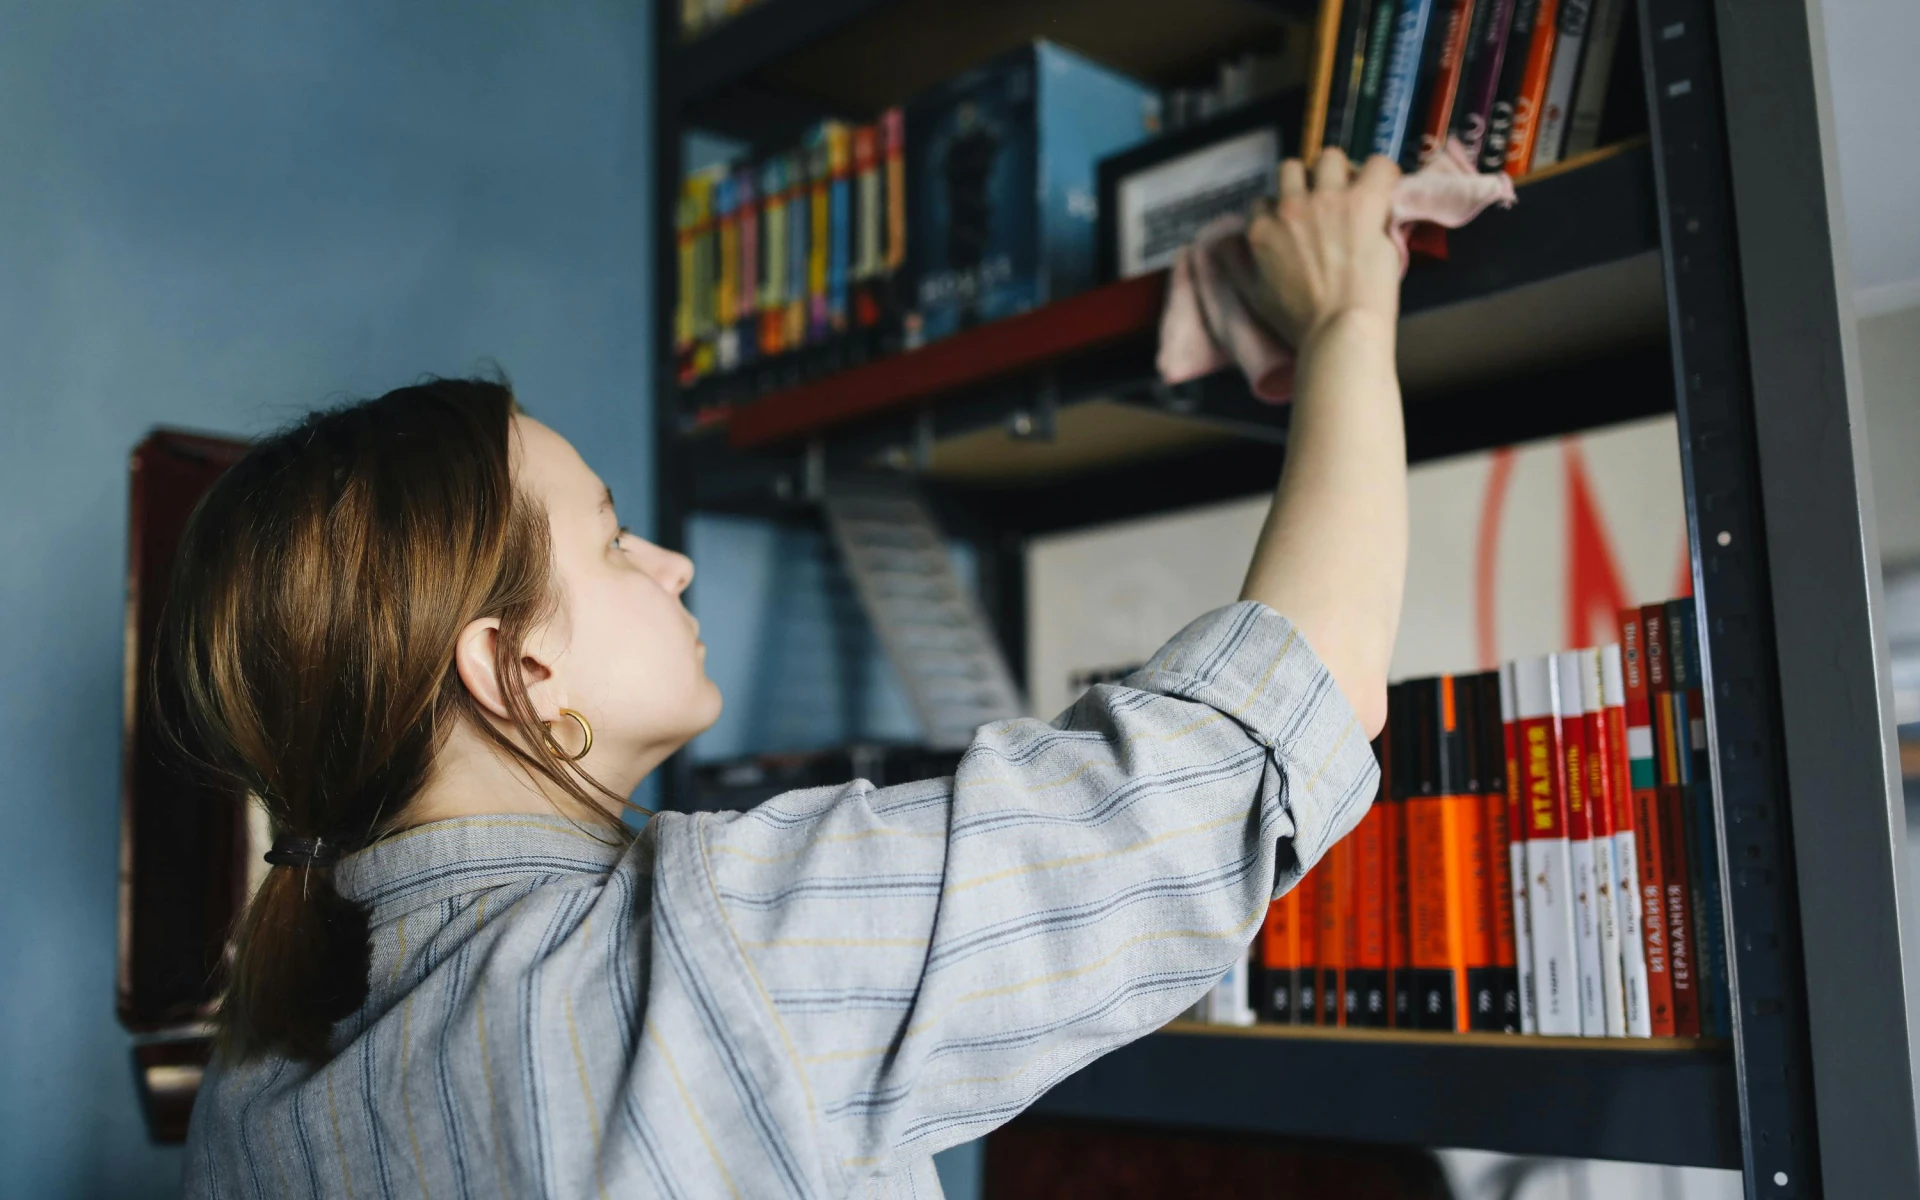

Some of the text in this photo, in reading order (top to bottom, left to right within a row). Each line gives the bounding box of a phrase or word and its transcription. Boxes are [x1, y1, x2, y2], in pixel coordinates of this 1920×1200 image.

[1528, 725, 1552, 829] ИТАЛИЯ
[1644, 885, 1665, 973] ИТАЛИЯ
[1667, 884, 1690, 990] ГЕРМАНИЯ
